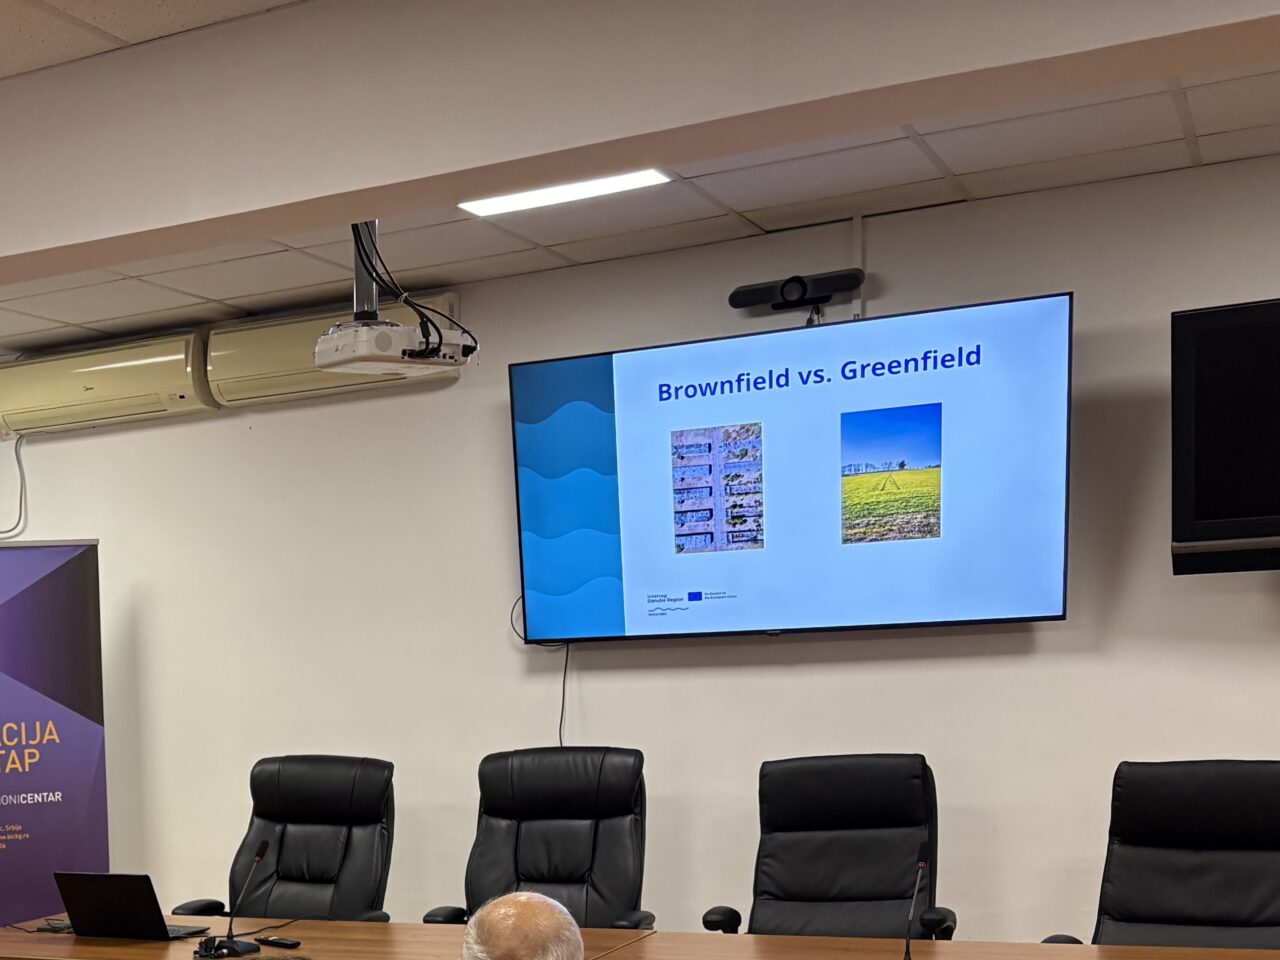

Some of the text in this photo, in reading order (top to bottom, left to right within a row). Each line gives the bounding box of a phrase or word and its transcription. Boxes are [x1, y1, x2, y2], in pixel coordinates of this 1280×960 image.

[658, 344, 982, 401] Brownfield vs. Greenfield
